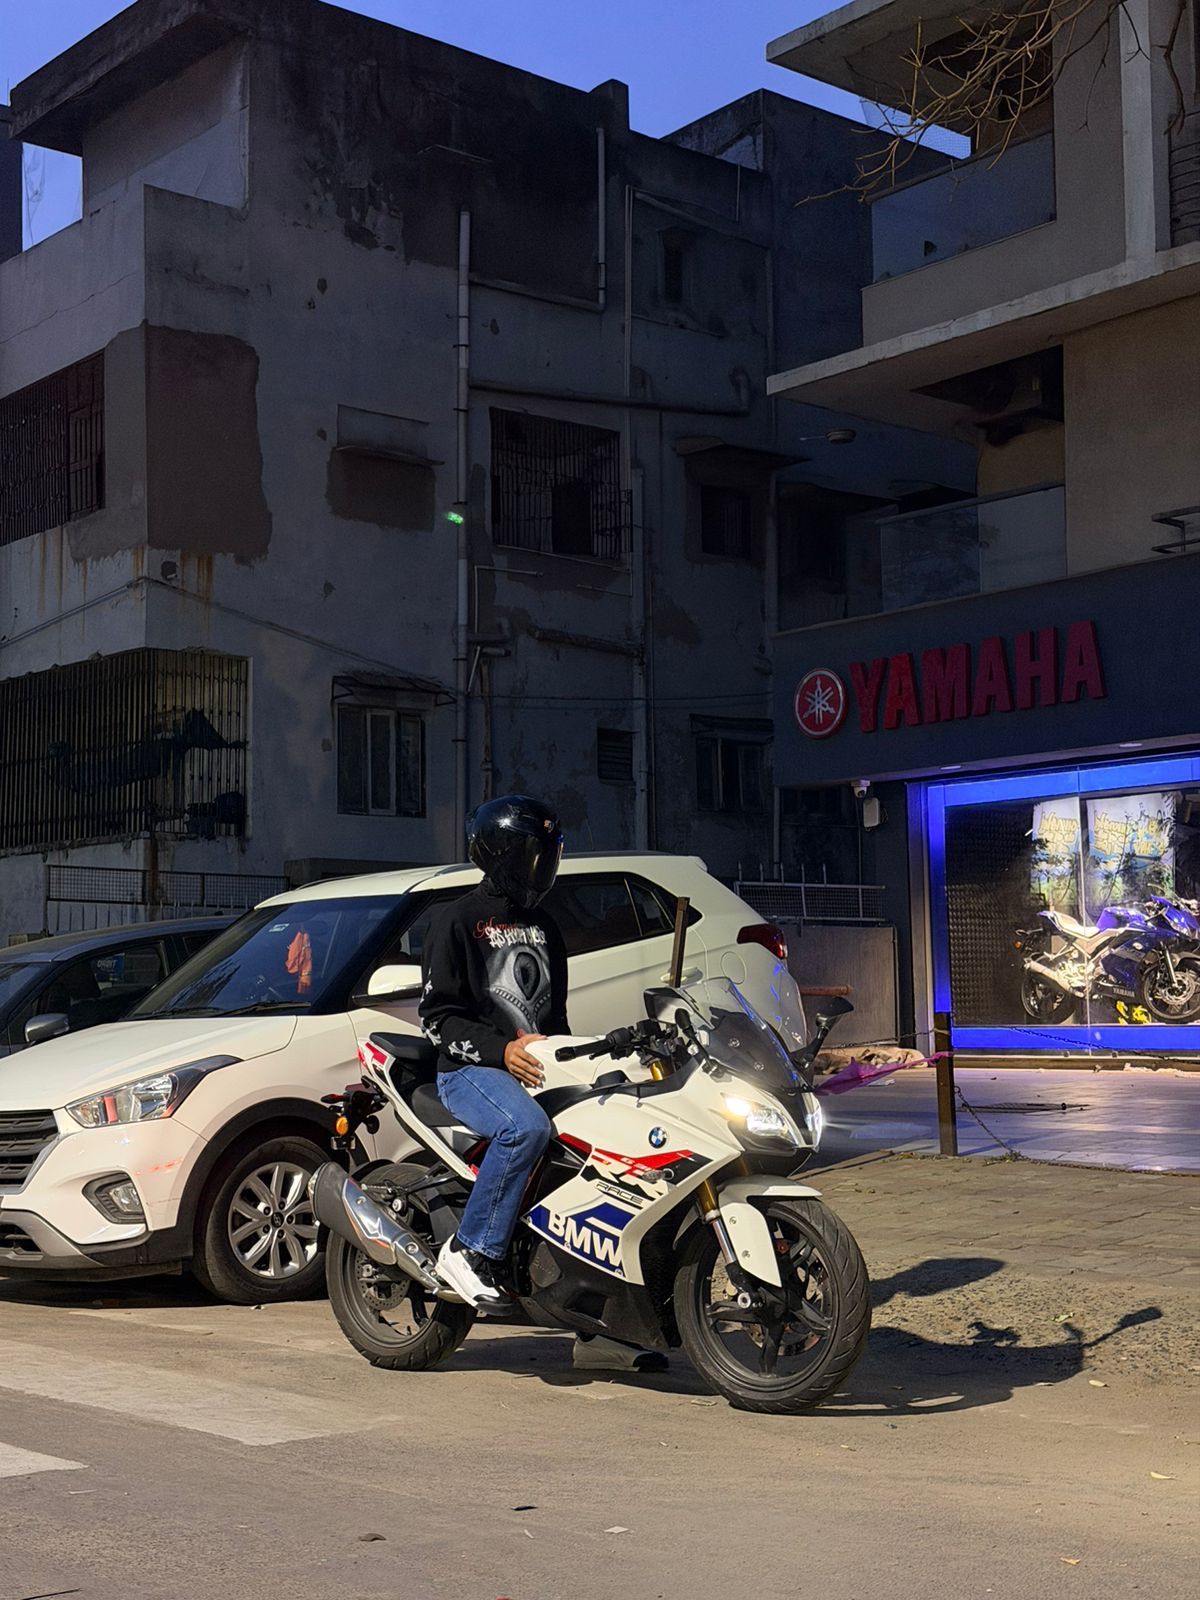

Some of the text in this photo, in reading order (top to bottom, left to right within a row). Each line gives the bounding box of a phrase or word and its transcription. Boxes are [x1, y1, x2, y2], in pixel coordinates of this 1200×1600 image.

[848, 619, 1106, 733] YAMAHA
[596, 1182, 643, 1205] RACE
[548, 1209, 622, 1267] BMW
